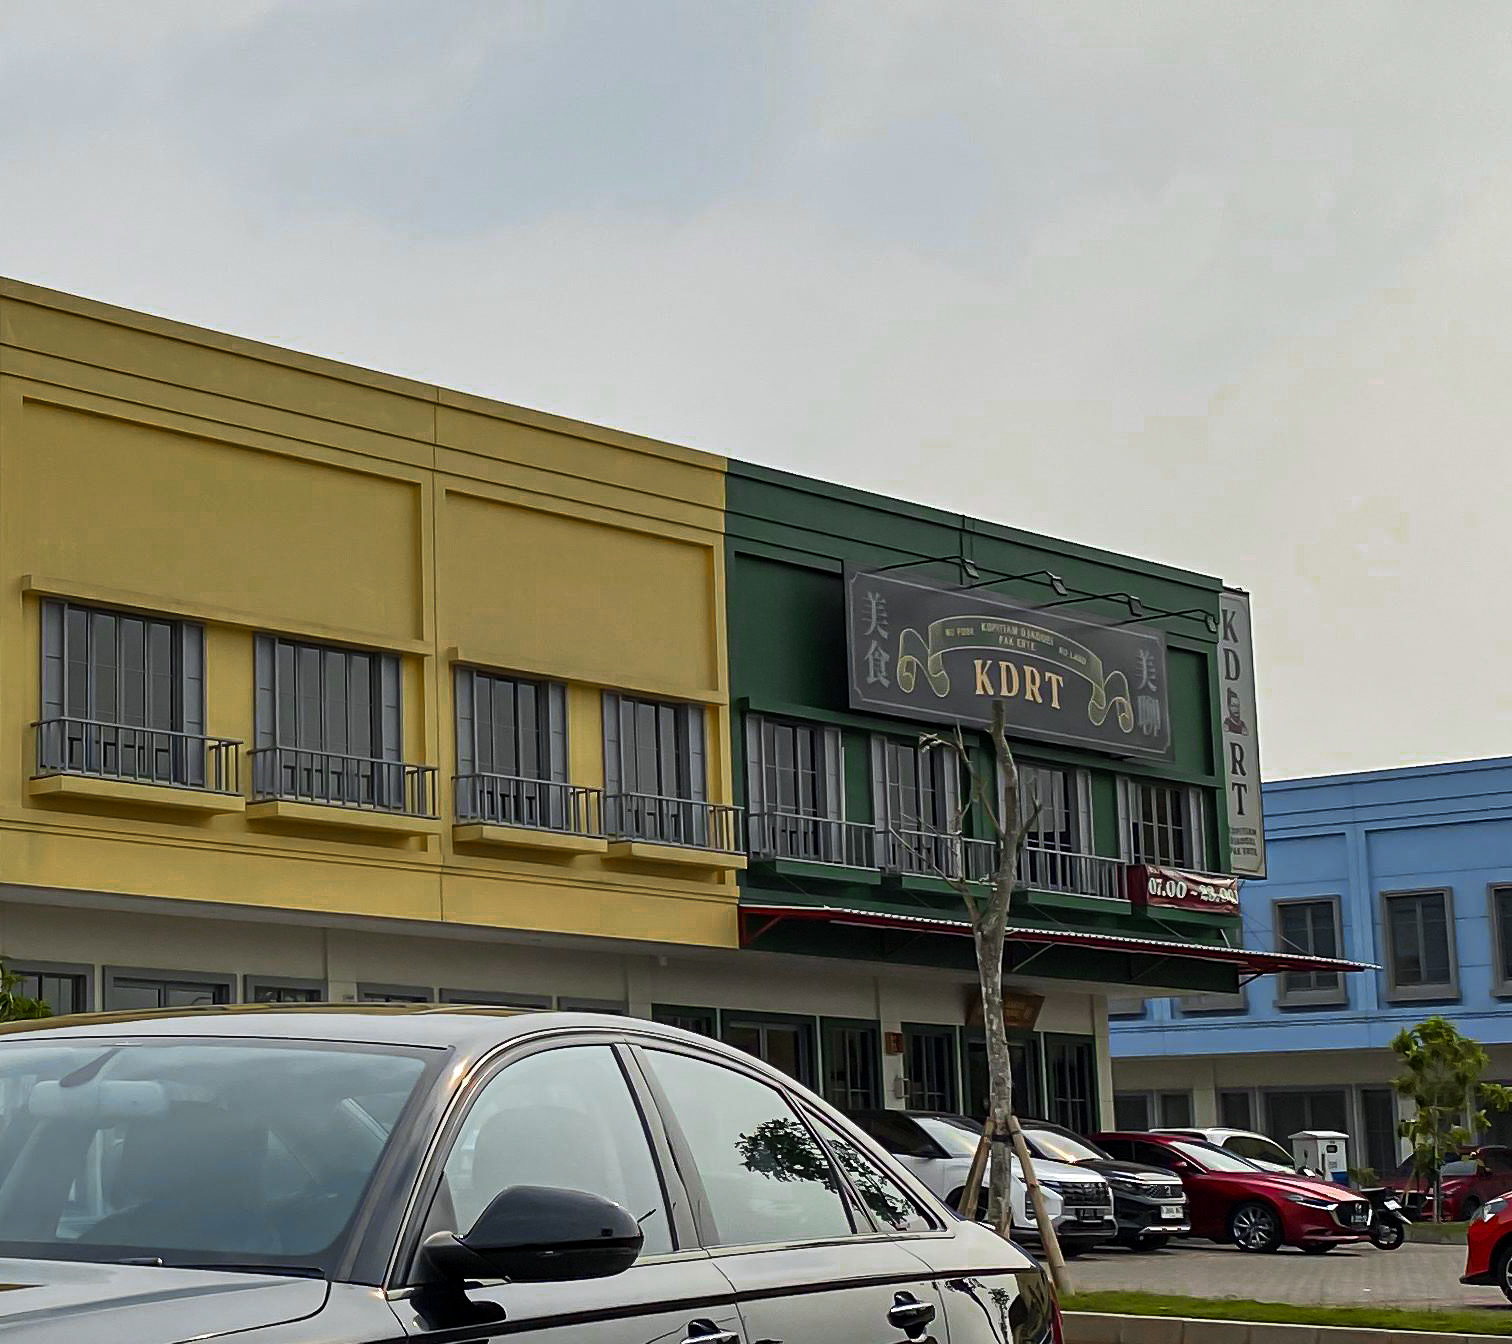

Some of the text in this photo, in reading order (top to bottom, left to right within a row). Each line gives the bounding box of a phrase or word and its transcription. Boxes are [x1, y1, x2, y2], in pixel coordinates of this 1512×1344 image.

[861, 592, 890, 688] 美食
[974, 659, 1064, 709] KDRT
[1148, 877, 1188, 899] 07.00
